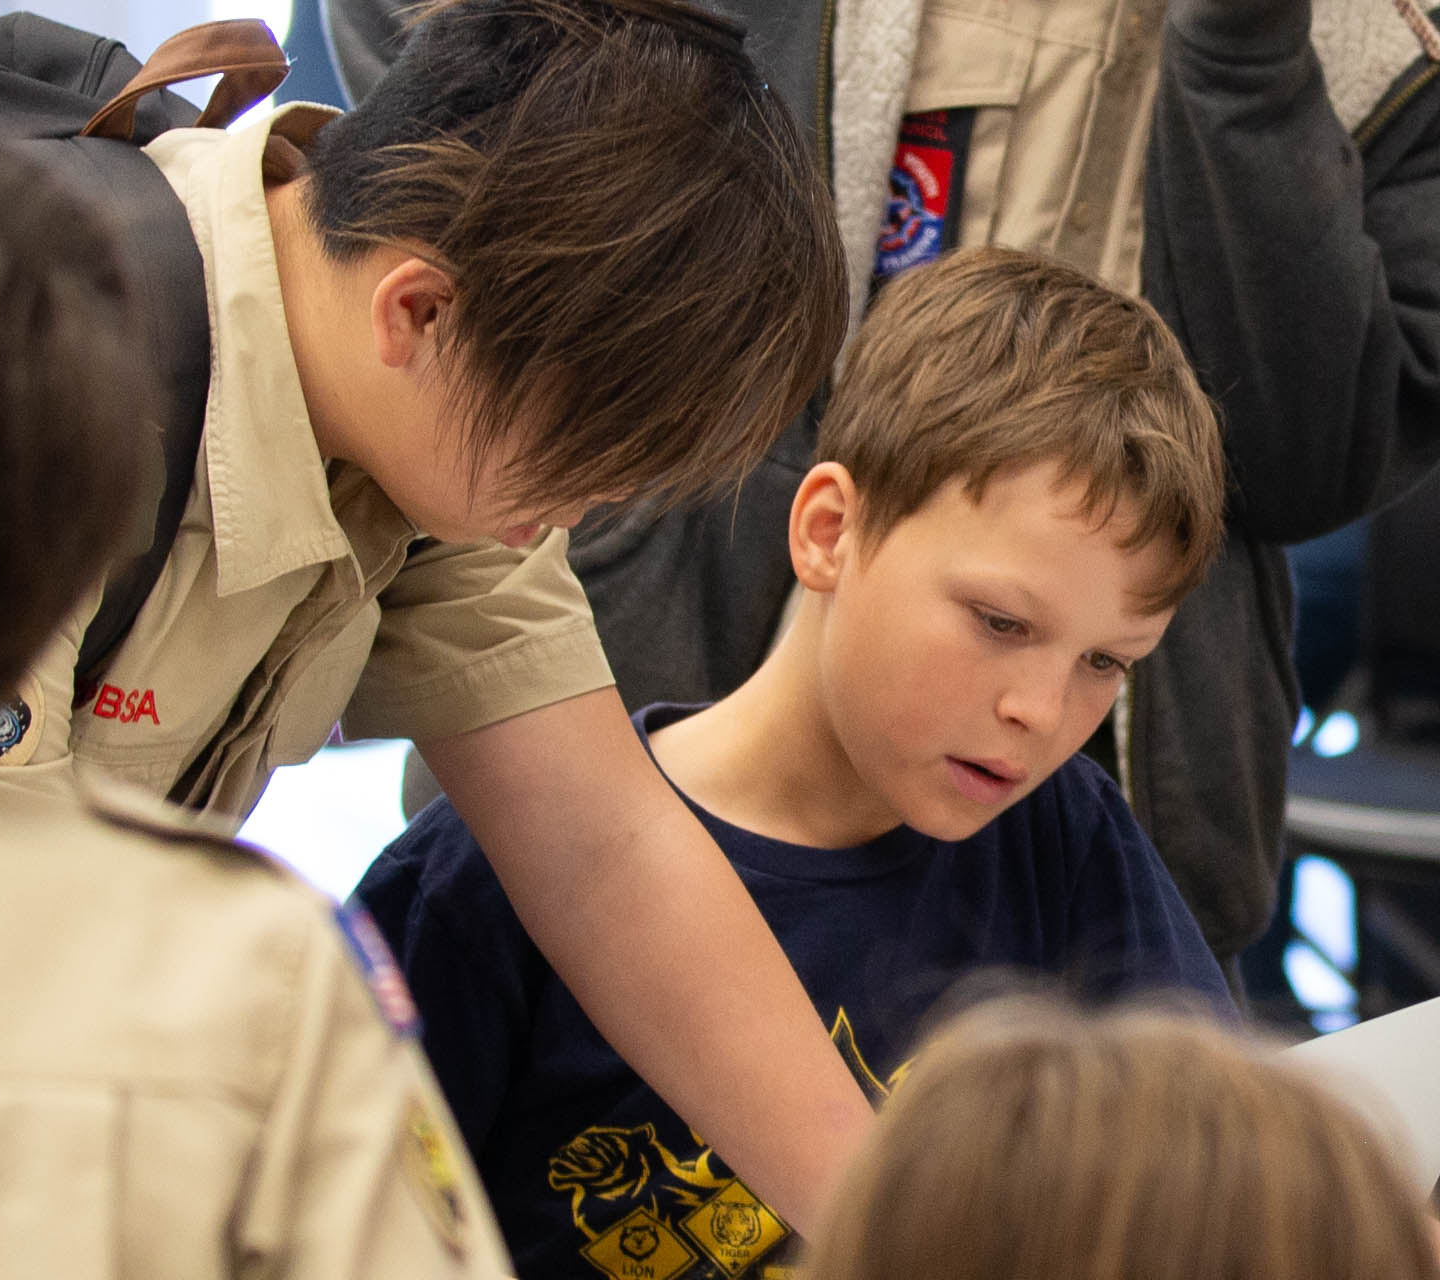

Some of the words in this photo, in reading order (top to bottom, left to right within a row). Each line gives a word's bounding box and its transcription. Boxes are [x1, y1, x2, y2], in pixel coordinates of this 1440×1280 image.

[93, 683, 161, 726] BSA
[720, 1247, 750, 1260] TIGER
[622, 1263, 655, 1279] LION
